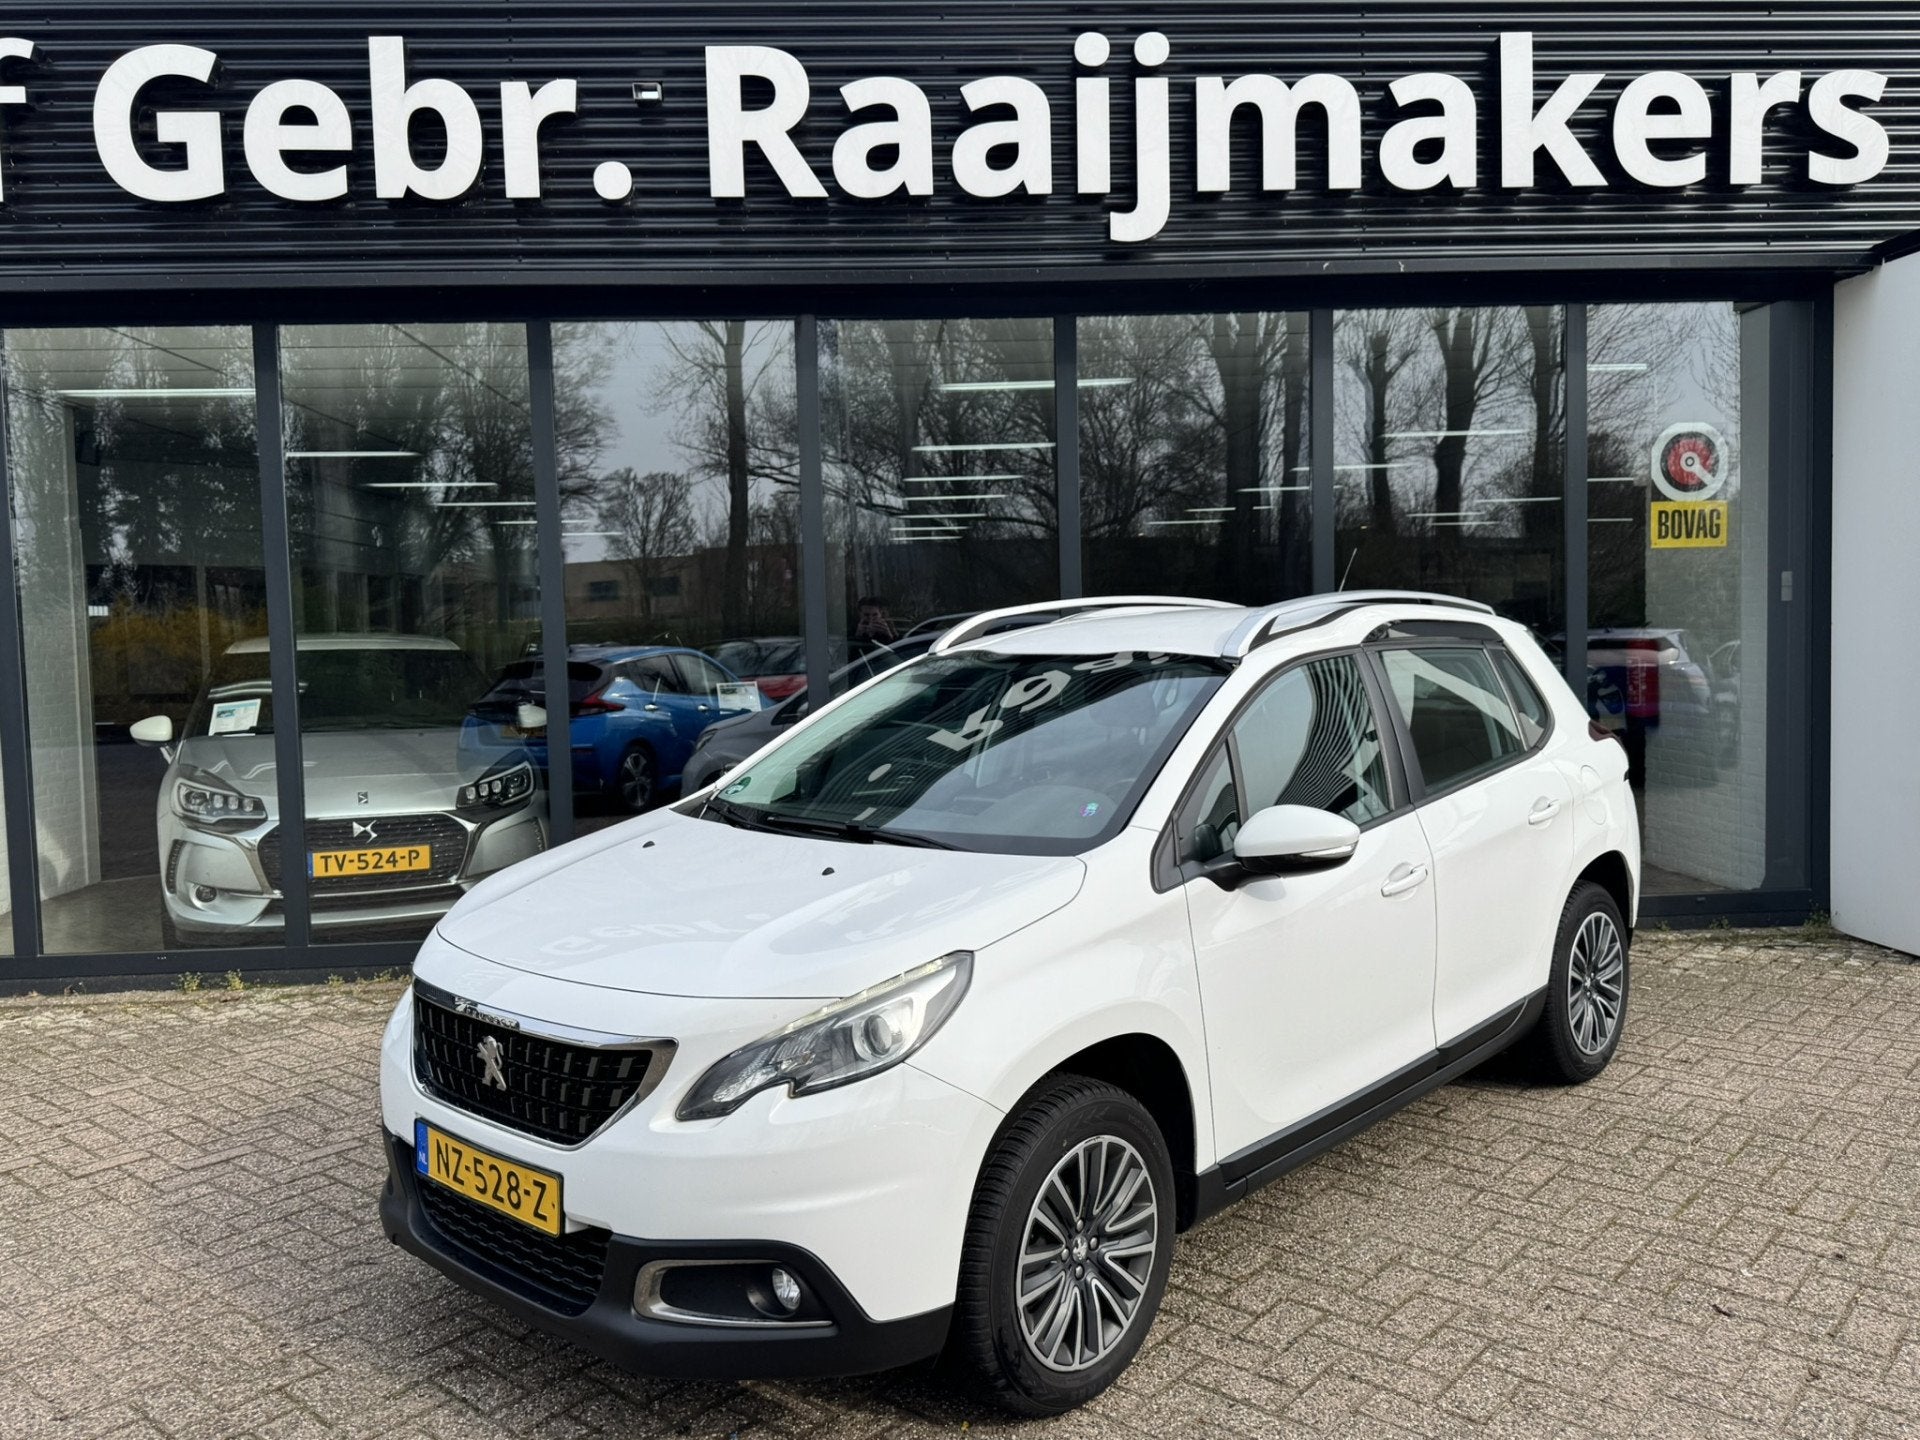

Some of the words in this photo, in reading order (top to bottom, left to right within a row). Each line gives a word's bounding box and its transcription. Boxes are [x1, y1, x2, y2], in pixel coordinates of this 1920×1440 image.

[93, 36, 632, 202] Gebr.
[705, 31, 1890, 242] Raaijmakers
[1657, 508, 1721, 540] BOVAG
[320, 849, 420, 873] TV-524-P
[436, 1138, 548, 1223] NZ-528-Z
